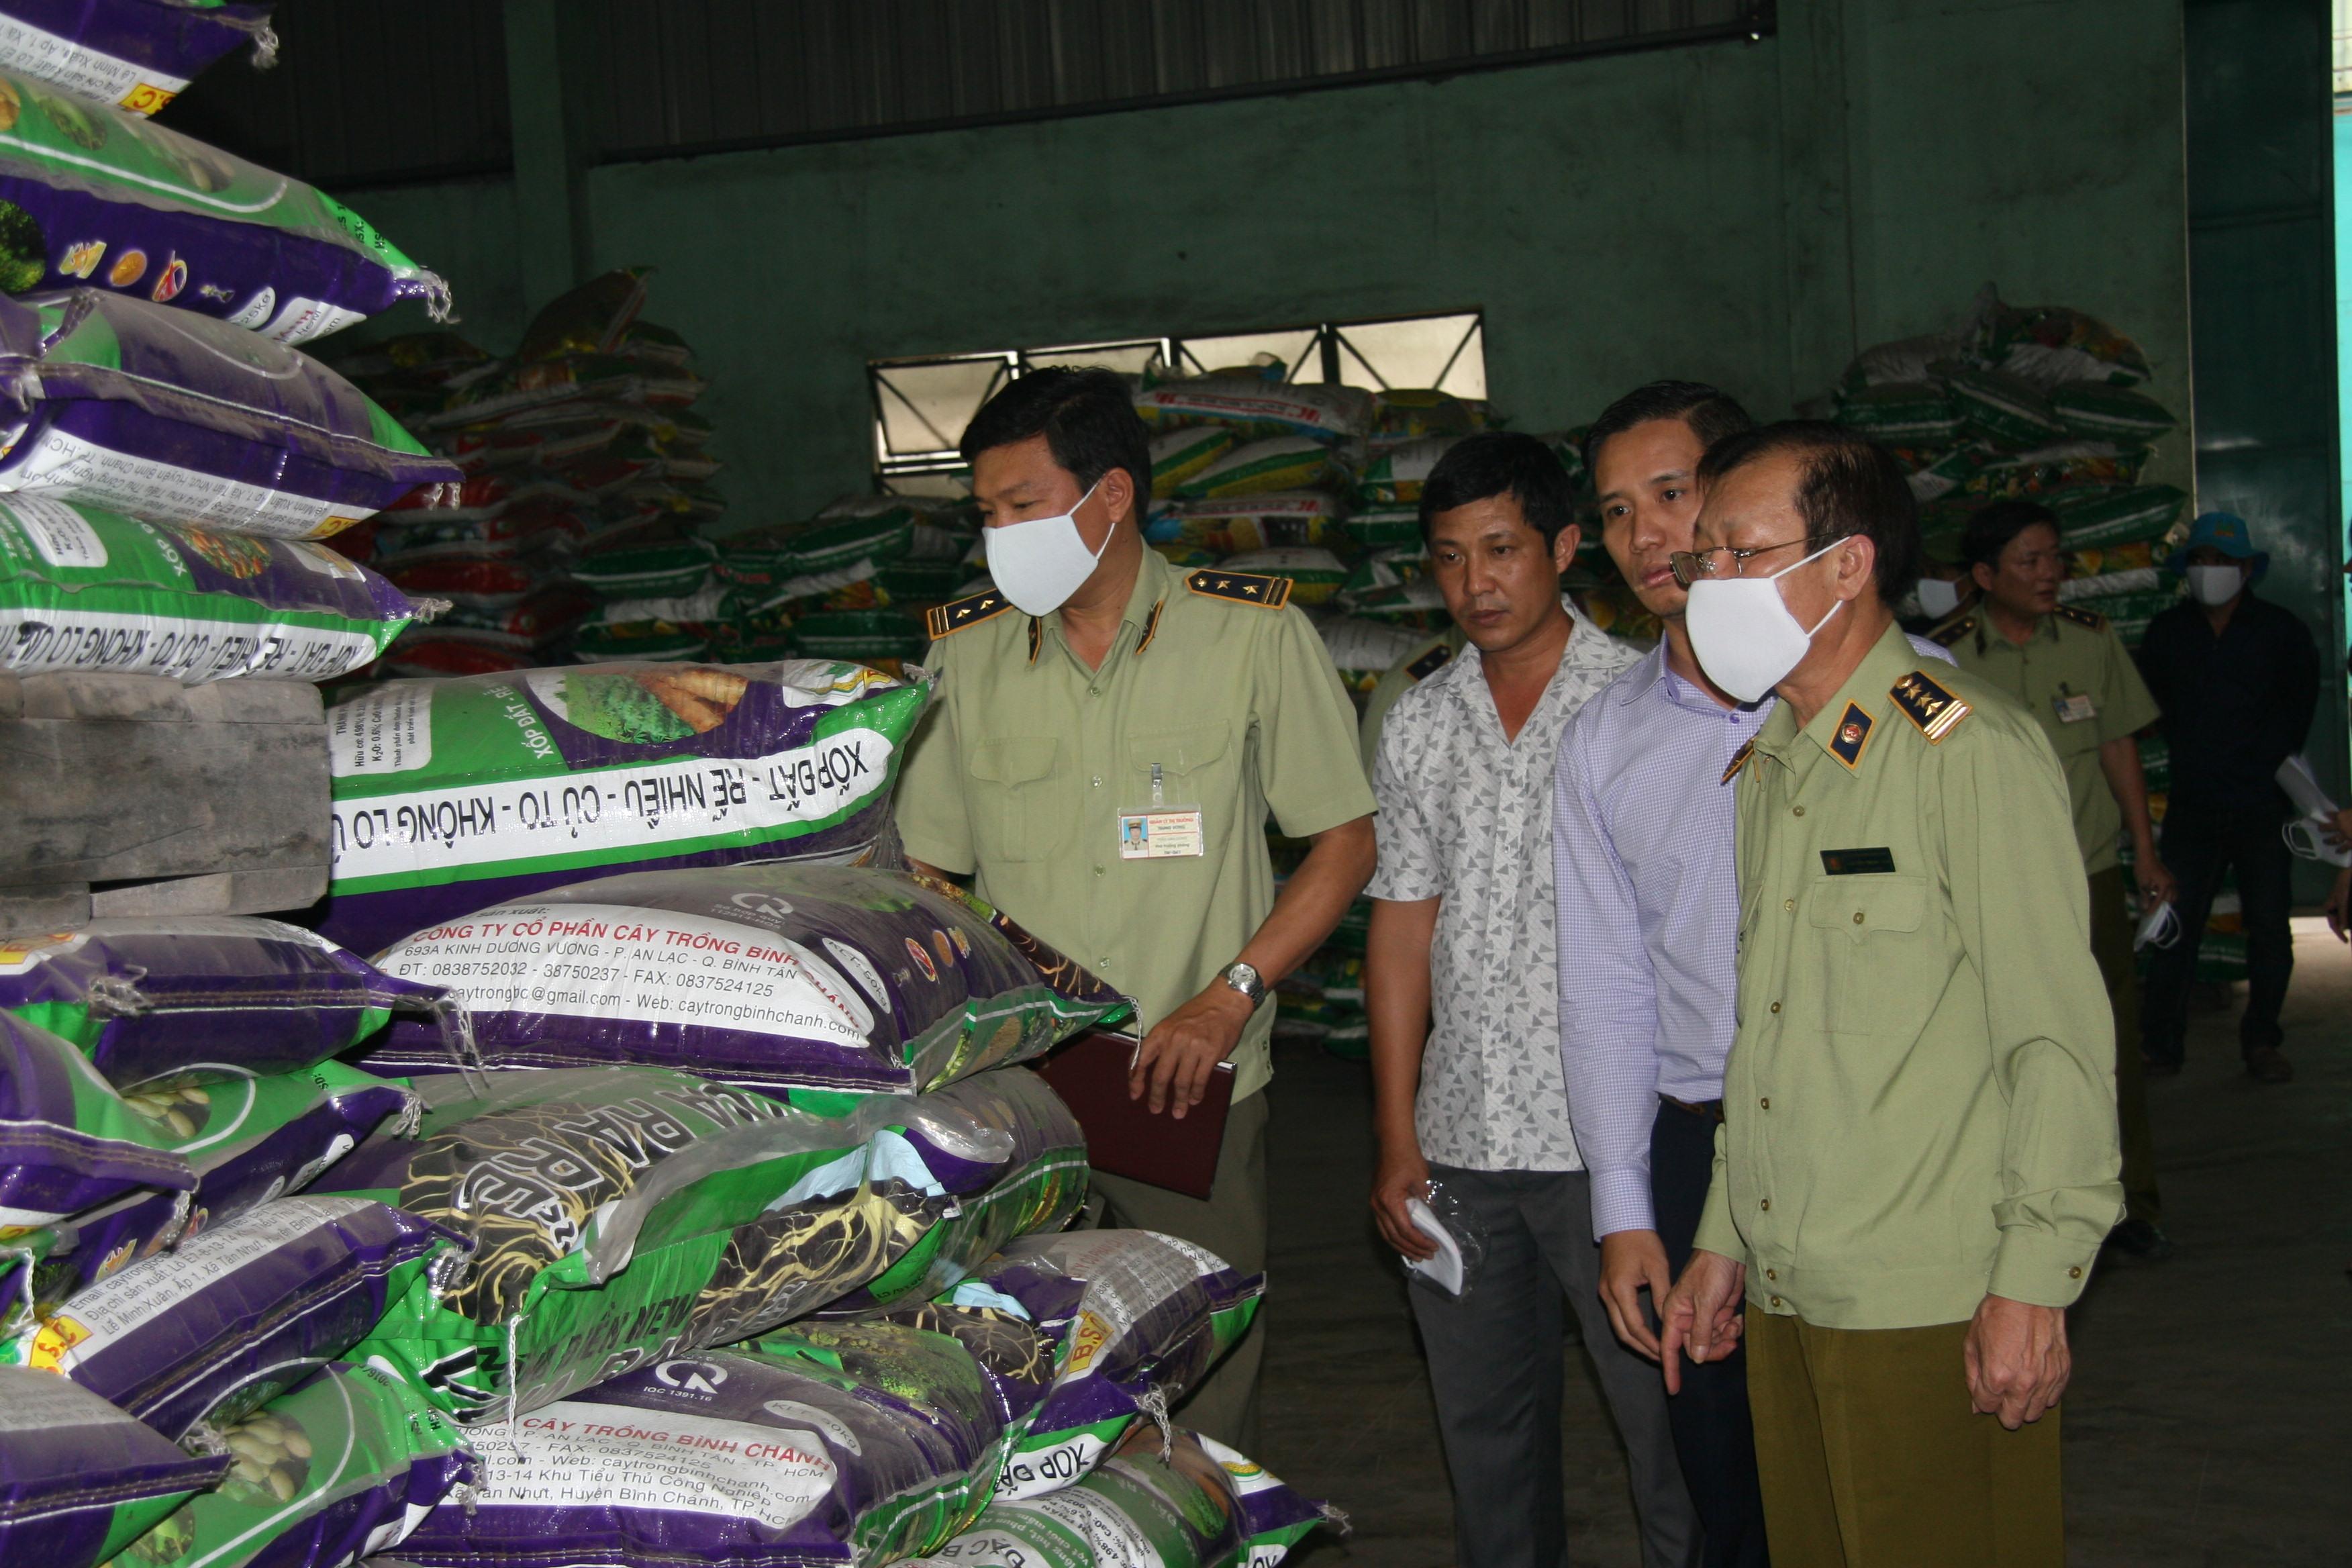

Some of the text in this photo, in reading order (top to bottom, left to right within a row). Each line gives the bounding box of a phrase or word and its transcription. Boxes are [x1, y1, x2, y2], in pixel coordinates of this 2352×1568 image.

[503, 703, 554, 760] XỐP ĐẤT
[354, 749, 365, 768] Hữu
[818, 740, 869, 796] XỐP
[518, 790, 558, 830] TO
[624, 772, 707, 830] NHIỀU
[708, 767, 747, 822] RỄ
[769, 759, 816, 812] ĐẤT
[353, 808, 391, 850] LO
[397, 796, 496, 850] KHÔNG
[562, 785, 601, 839] CỦ
[405, 945, 440, 957] 693A
[444, 942, 482, 955] KINH
[486, 941, 541, 954] DƯƠNG
[546, 942, 600, 957] VƯƠNG
[632, 948, 655, 962] AN
[657, 950, 689, 965] LẠC
[702, 955, 718, 969] Q.
[722, 958, 762, 975] BÌNH
[767, 965, 799, 980] TÂN
[412, 924, 474, 942] CÔNG
[481, 923, 509, 937] TY
[512, 916, 548, 937] CỔ
[548, 916, 609, 939] PHẦN
[614, 922, 660, 942] CÂY
[665, 929, 742, 955] TRỒNG
[746, 945, 801, 967] BÌNH
[399, 961, 775, 997] ĐT: 0838752032 38750237 FAX: 0837524125
[637, 993, 674, 1011] Web:
[678, 998, 861, 1042] caytrongbinhchanh.com
[313, 1073, 329, 1091] SD:
[68, 1289, 109, 1310] Email:
[85, 1304, 109, 1321] Địa
[107, 1293, 126, 1310] chỉ
[124, 1283, 146, 1300] sản
[143, 1269, 173, 1288] xuất:
[167, 1259, 187, 1273] Lô
[116, 1304, 146, 1326] Minh
[142, 1288, 179, 1310] Xuân,
[201, 1261, 221, 1276] Xã
[215, 1251, 239, 1269] Tân
[642, 1385, 713, 1402] IQC 1391.16
[524, 1418, 832, 1471] CÂY TRỒNG BÌNH CHÁNH
[545, 1432, 570, 1441] AN
[650, 1442, 699, 1456] BÌNH
[701, 1451, 736, 1465] TÂN
[783, 1468, 826, 1477] HCM
[548, 1442, 712, 1471] FAX: 0837524125
[508, 1486, 554, 1500] Nhựt,
[560, 1487, 613, 1503] Huyện
[619, 1487, 658, 1504] Bình
[663, 1490, 724, 1510] Chánh,
[538, 1469, 572, 1481] Khu
[579, 1467, 615, 1483] Tiểu
[621, 1471, 653, 1484] Thủ
[659, 1473, 705, 1493] Công
[710, 1482, 771, 1507] Nghiệp
[552, 1455, 597, 1467] Web:
[602, 1457, 811, 1504] caytrongbinhchanh.com
